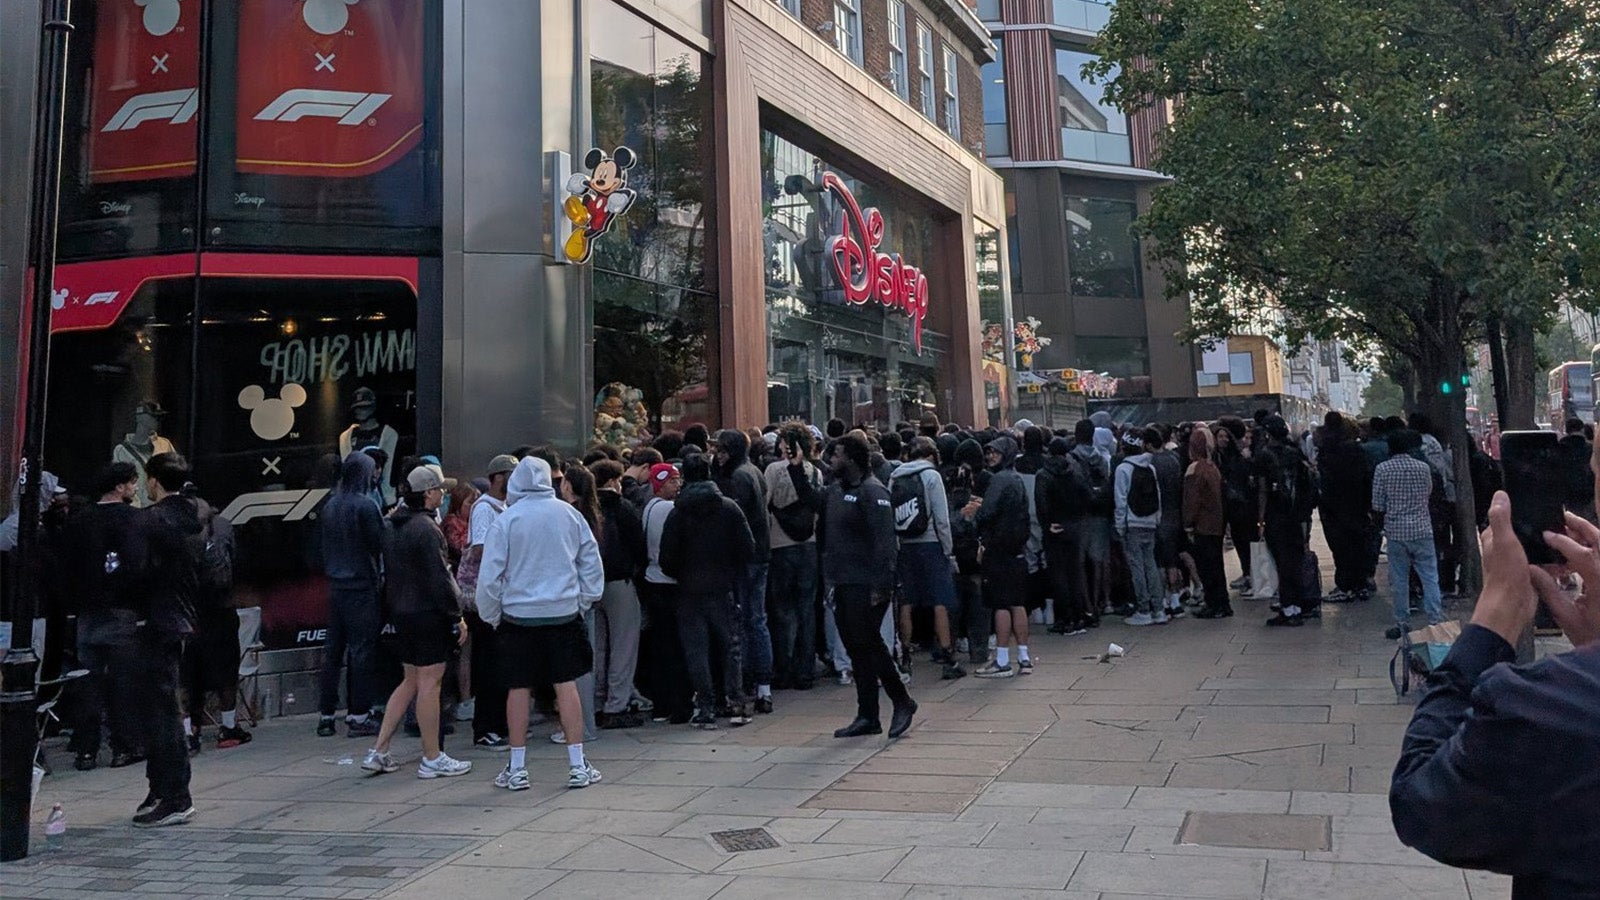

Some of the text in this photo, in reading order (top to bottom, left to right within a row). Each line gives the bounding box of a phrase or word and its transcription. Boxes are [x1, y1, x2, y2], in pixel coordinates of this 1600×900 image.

[253, 88, 393, 126] F1
[100, 200, 132, 215] Disney
[822, 170, 929, 357] Disney
[83, 291, 120, 306] F1
[220, 488, 331, 525] F1
[895, 497, 918, 523] NIKE
[296, 628, 328, 642] FUE
